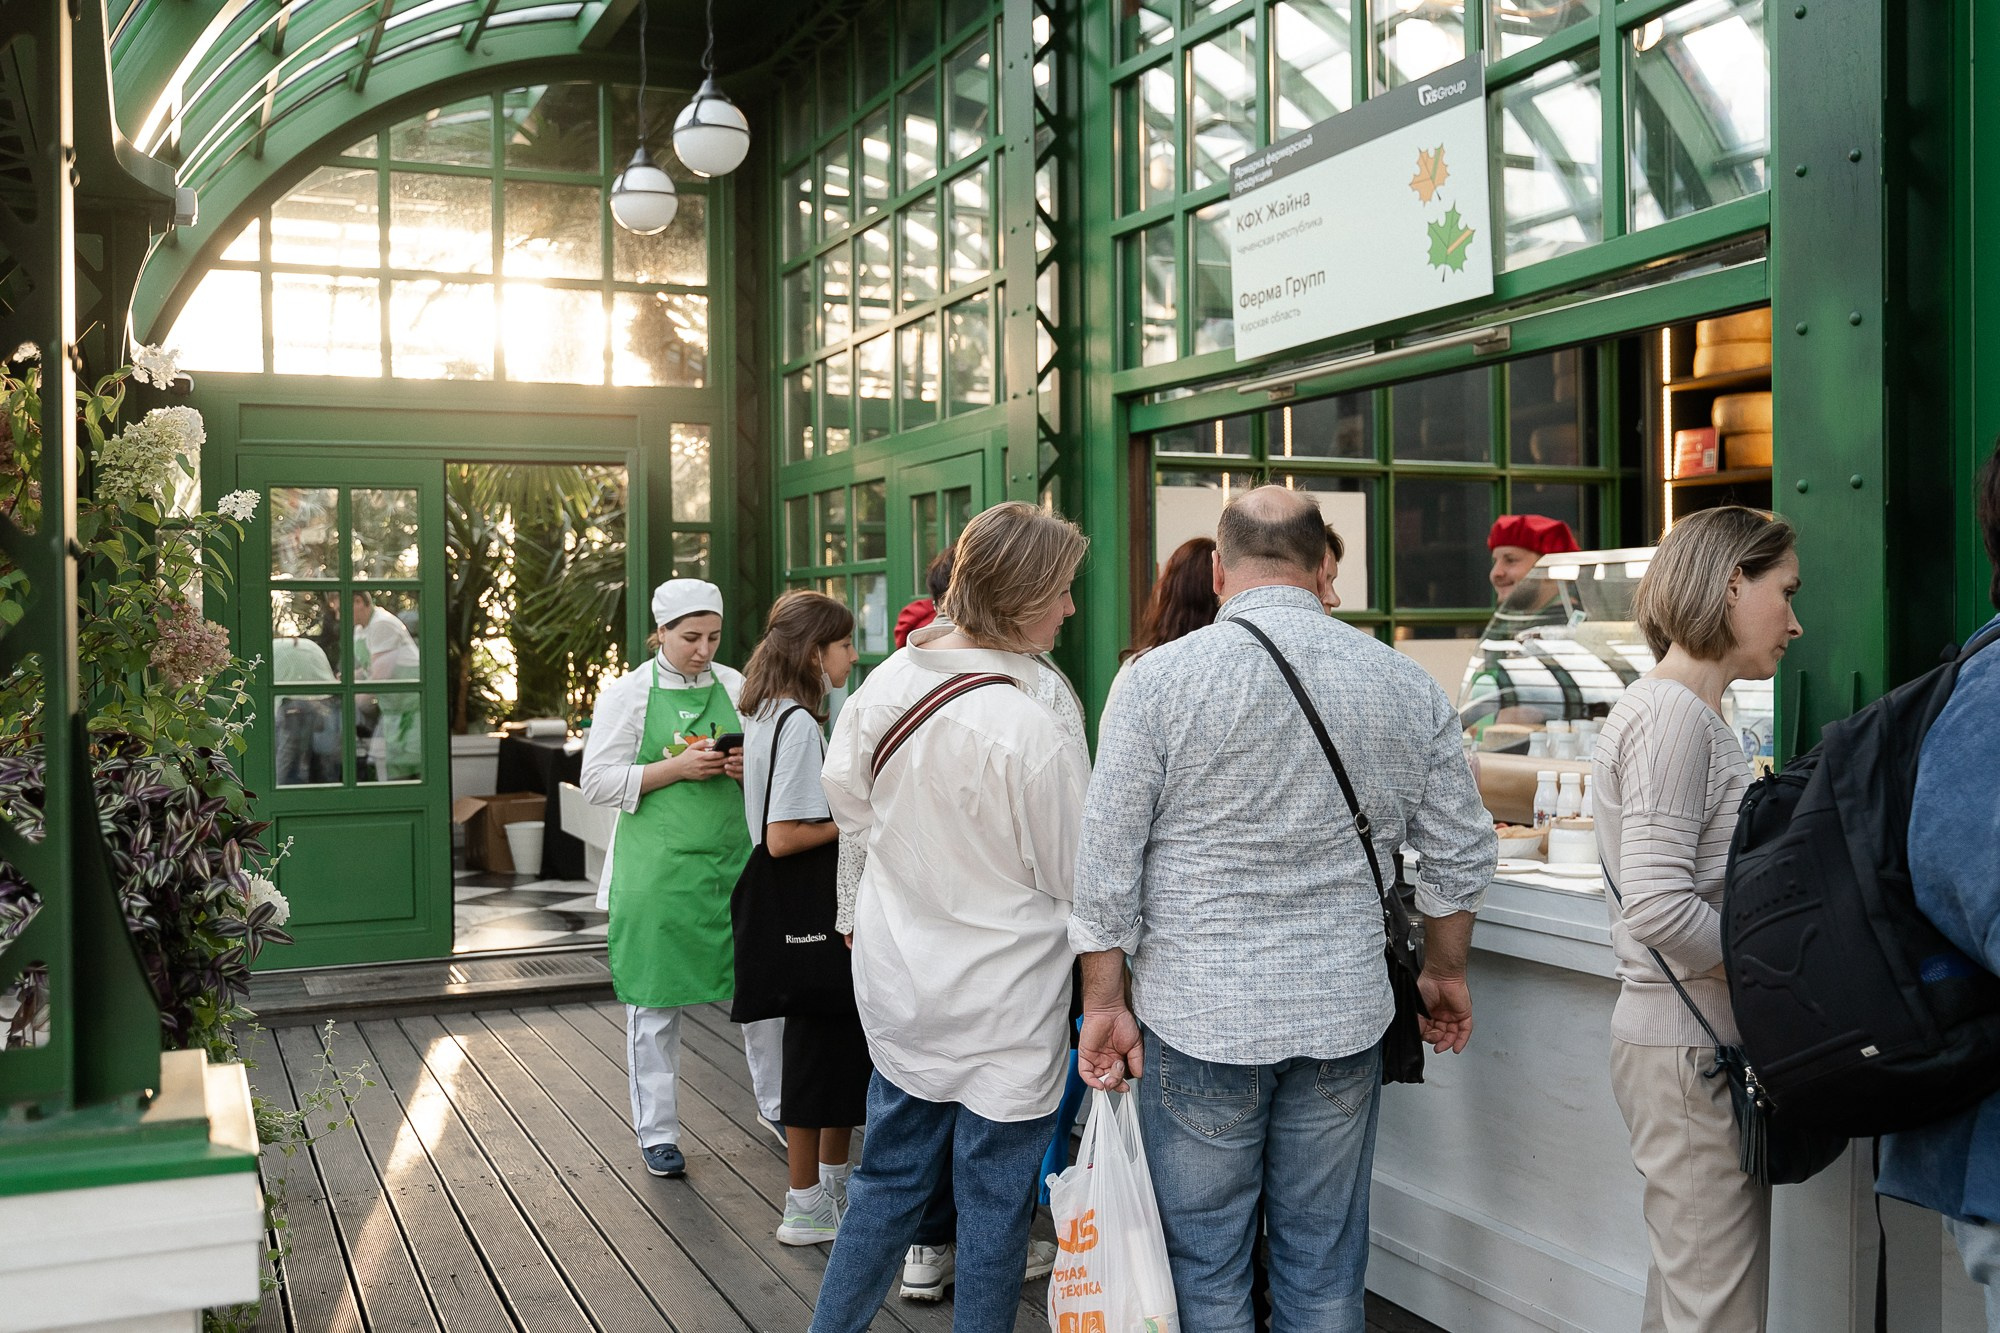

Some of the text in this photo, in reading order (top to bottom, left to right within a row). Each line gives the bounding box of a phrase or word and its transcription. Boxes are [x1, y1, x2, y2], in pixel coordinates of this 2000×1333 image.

[1236, 192, 1311, 233] КФХ Жайна
[1276, 216, 1323, 244] республика
[1239, 270, 1326, 309] Ферма Групп
[1240, 308, 1302, 333] Курская область
[785, 932, 827, 944] Rimadesio
